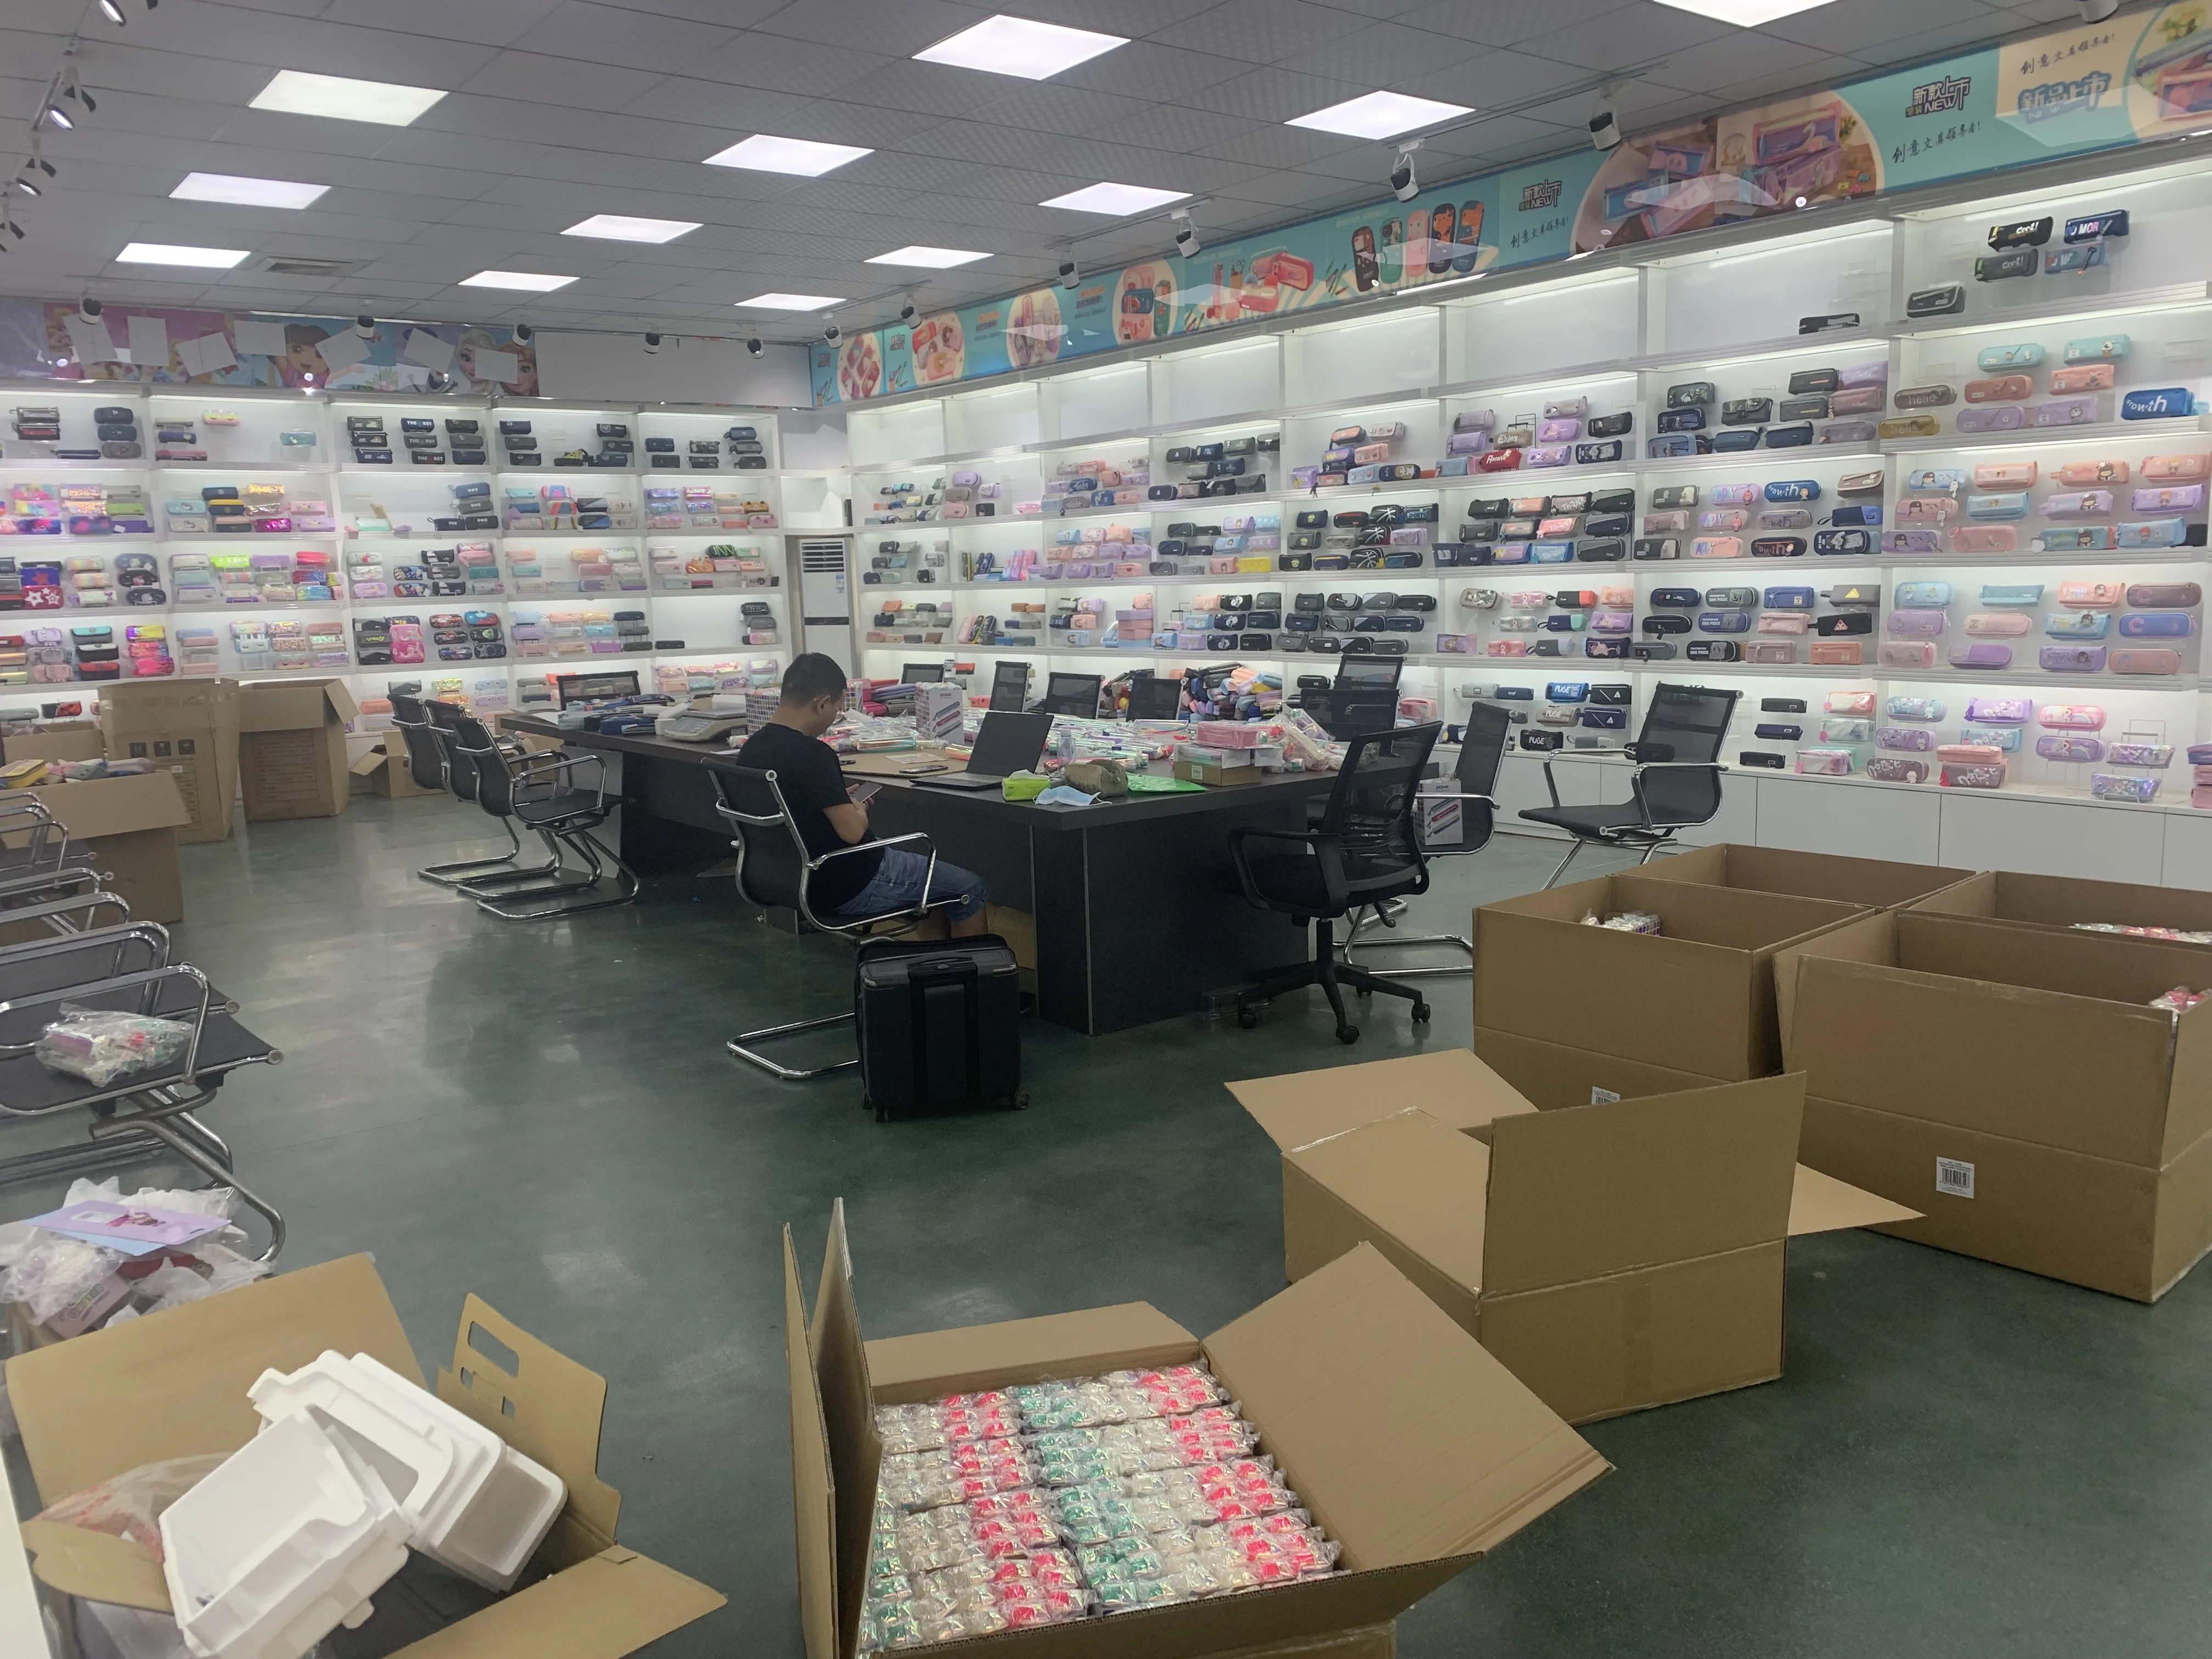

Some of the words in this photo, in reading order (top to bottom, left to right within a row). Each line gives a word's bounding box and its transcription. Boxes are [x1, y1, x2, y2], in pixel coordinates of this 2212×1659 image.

[1913, 76, 1971, 110] 新款上市
[1925, 98, 1955, 113] NEW
[1531, 198, 1553, 209] NEW
